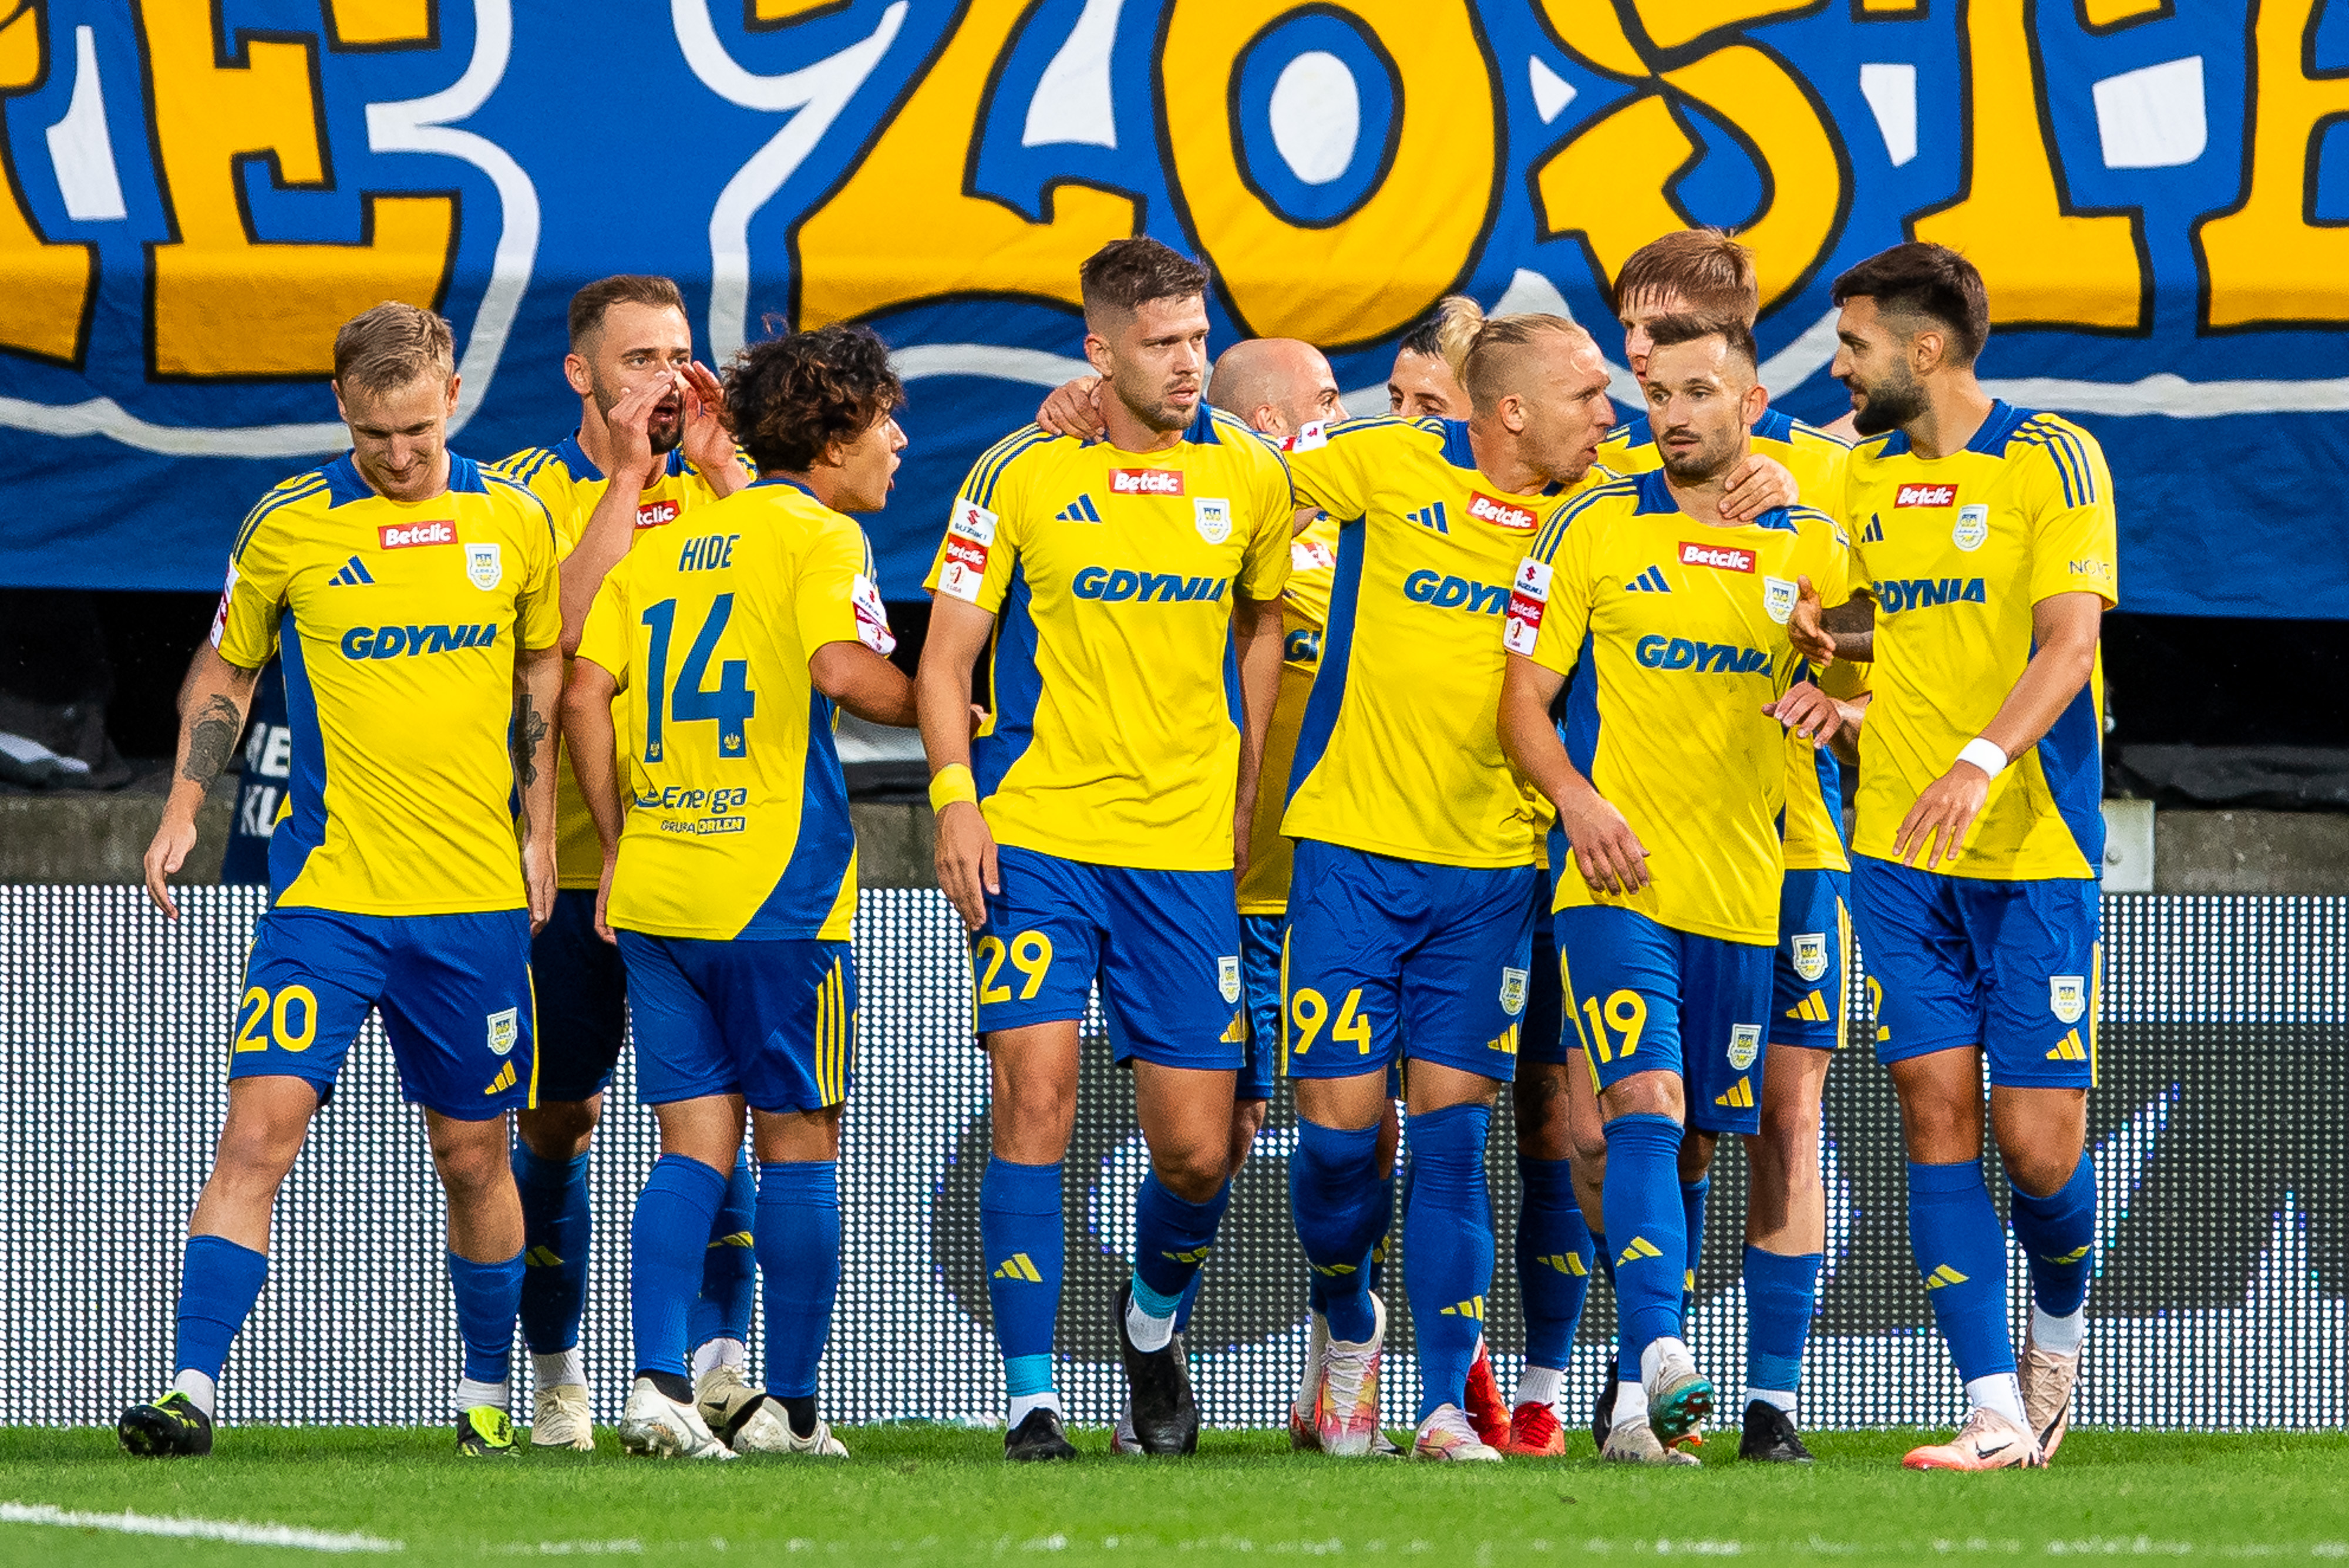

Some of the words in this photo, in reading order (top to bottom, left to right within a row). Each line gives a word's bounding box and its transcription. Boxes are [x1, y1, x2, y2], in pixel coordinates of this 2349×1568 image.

[1113, 471, 1179, 493] Betclic
[1897, 485, 1953, 505] Betclic
[1470, 497, 1532, 527] Betclic
[385, 523, 452, 546] Betclic
[679, 534, 741, 572] HIDE
[1683, 546, 1751, 570] Betclic
[341, 623, 497, 660] GDYNIA
[641, 592, 755, 763] 14
[662, 786, 748, 815] Energa
[977, 930, 1052, 1004] 29
[236, 985, 318, 1053] 20
[1292, 988, 1371, 1055] 94
[1583, 989, 1647, 1064] 19
